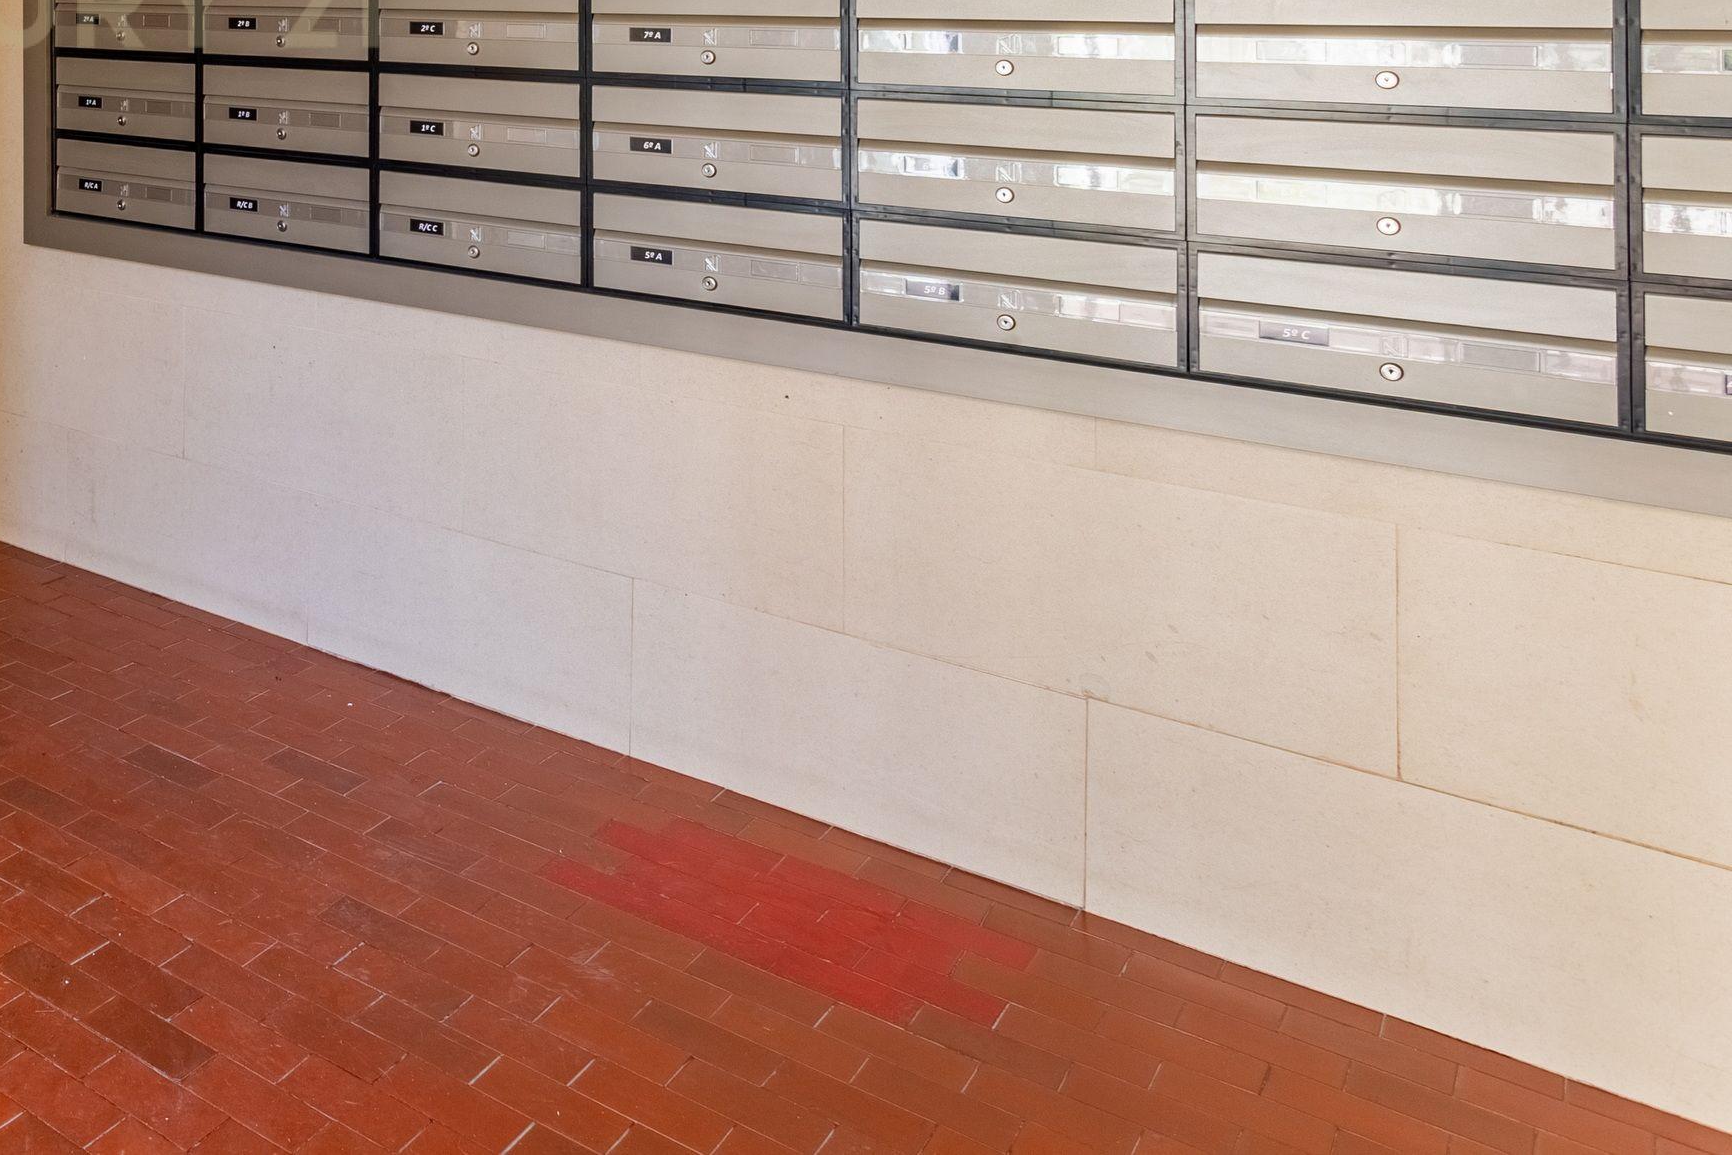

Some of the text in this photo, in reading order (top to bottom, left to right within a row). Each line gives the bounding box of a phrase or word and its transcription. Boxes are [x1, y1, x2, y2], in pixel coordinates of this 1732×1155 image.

[420, 24, 429, 32] 2º
[643, 31, 661, 39] 7º A
[421, 124, 429, 132] 1º
[643, 141, 661, 150] 6º A
[237, 200, 248, 209] R/C
[418, 223, 431, 231] R/C
[644, 251, 662, 260] 5º A
[923, 285, 945, 295] 5º B
[1282, 328, 1311, 339] 5º C
